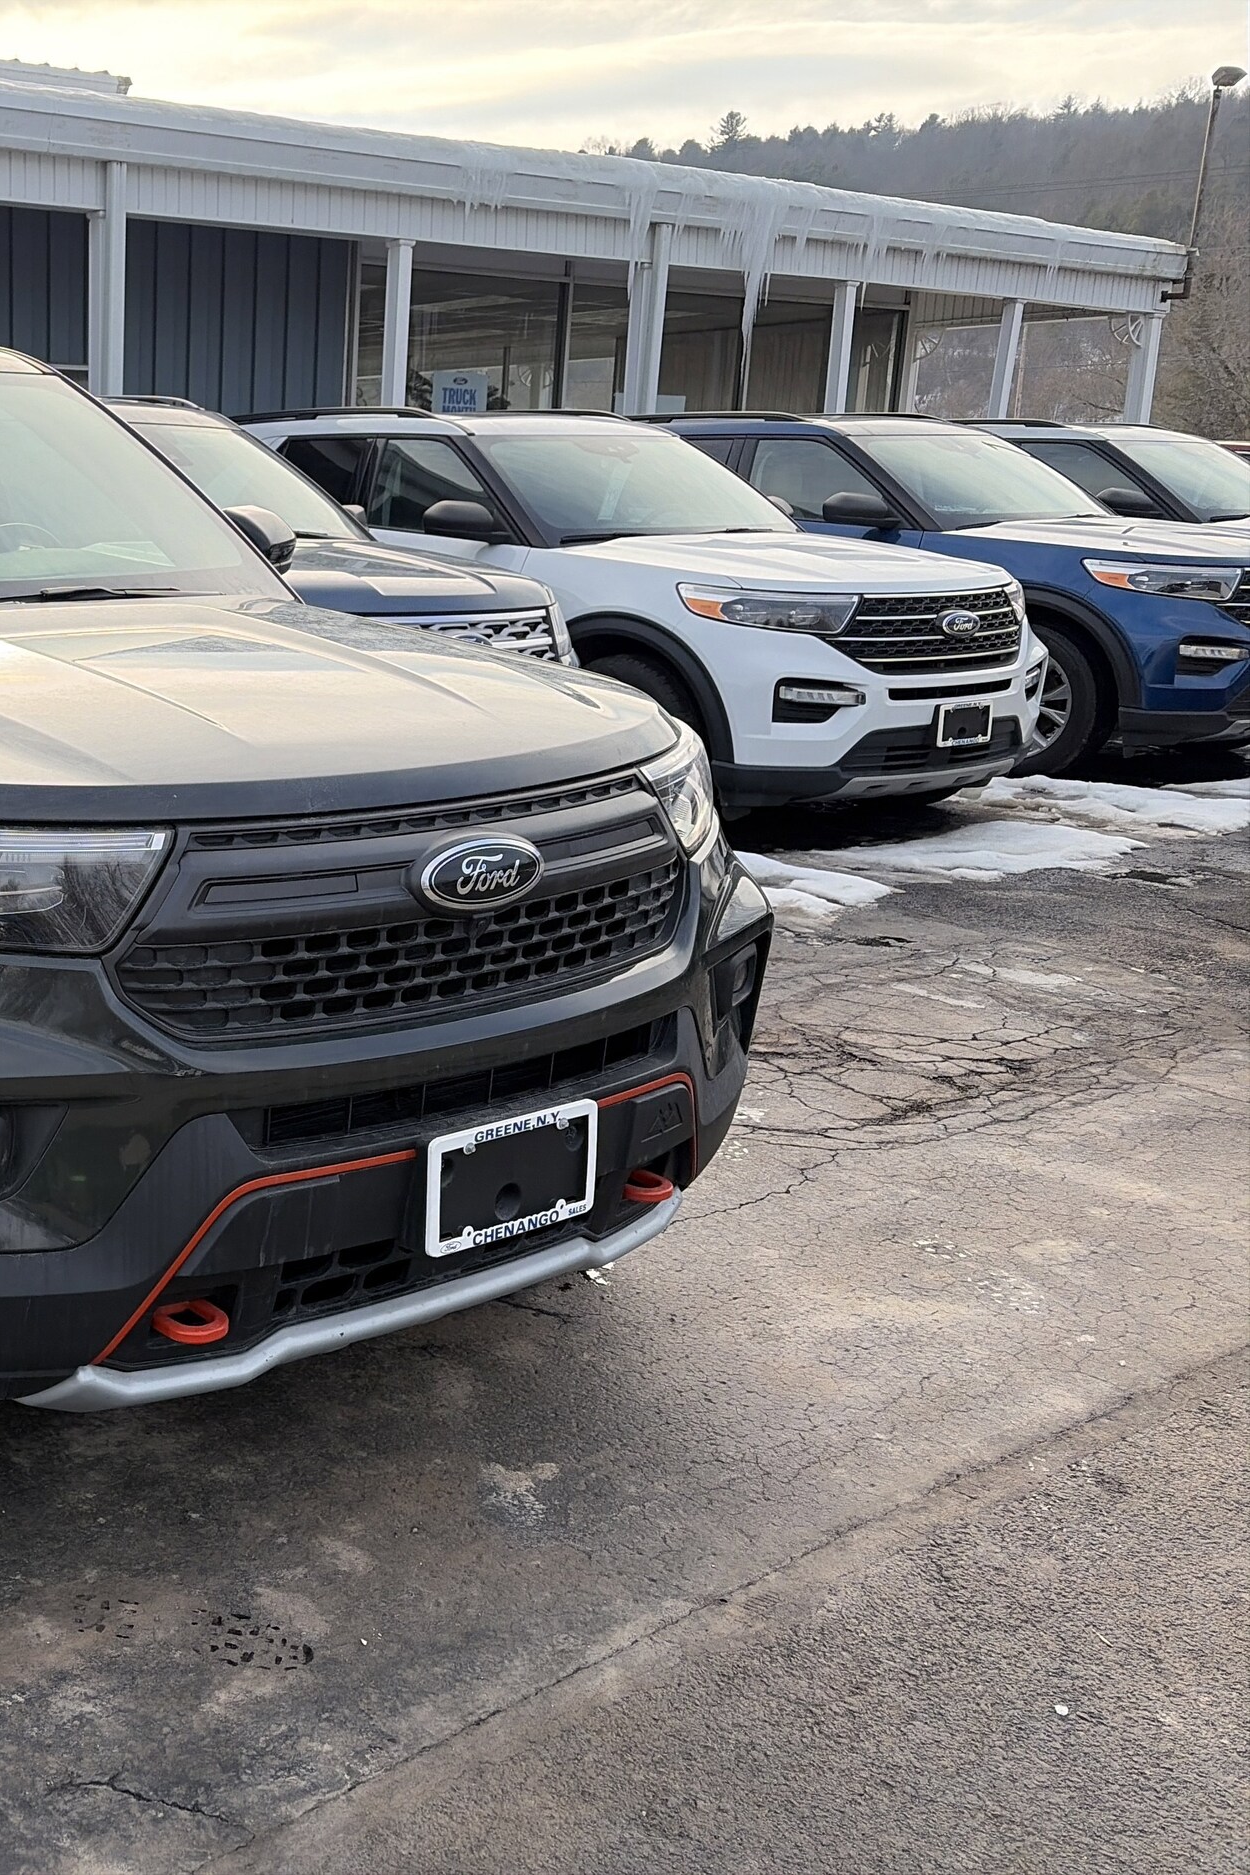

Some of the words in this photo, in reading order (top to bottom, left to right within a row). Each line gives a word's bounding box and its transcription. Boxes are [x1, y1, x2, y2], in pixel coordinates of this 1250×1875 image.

[442, 387, 477, 405] TRUCK
[953, 617, 974, 631] Ford
[456, 853, 521, 895] Ford
[472, 1210, 560, 1246] CHENANGO
[568, 1204, 587, 1216] SALES
